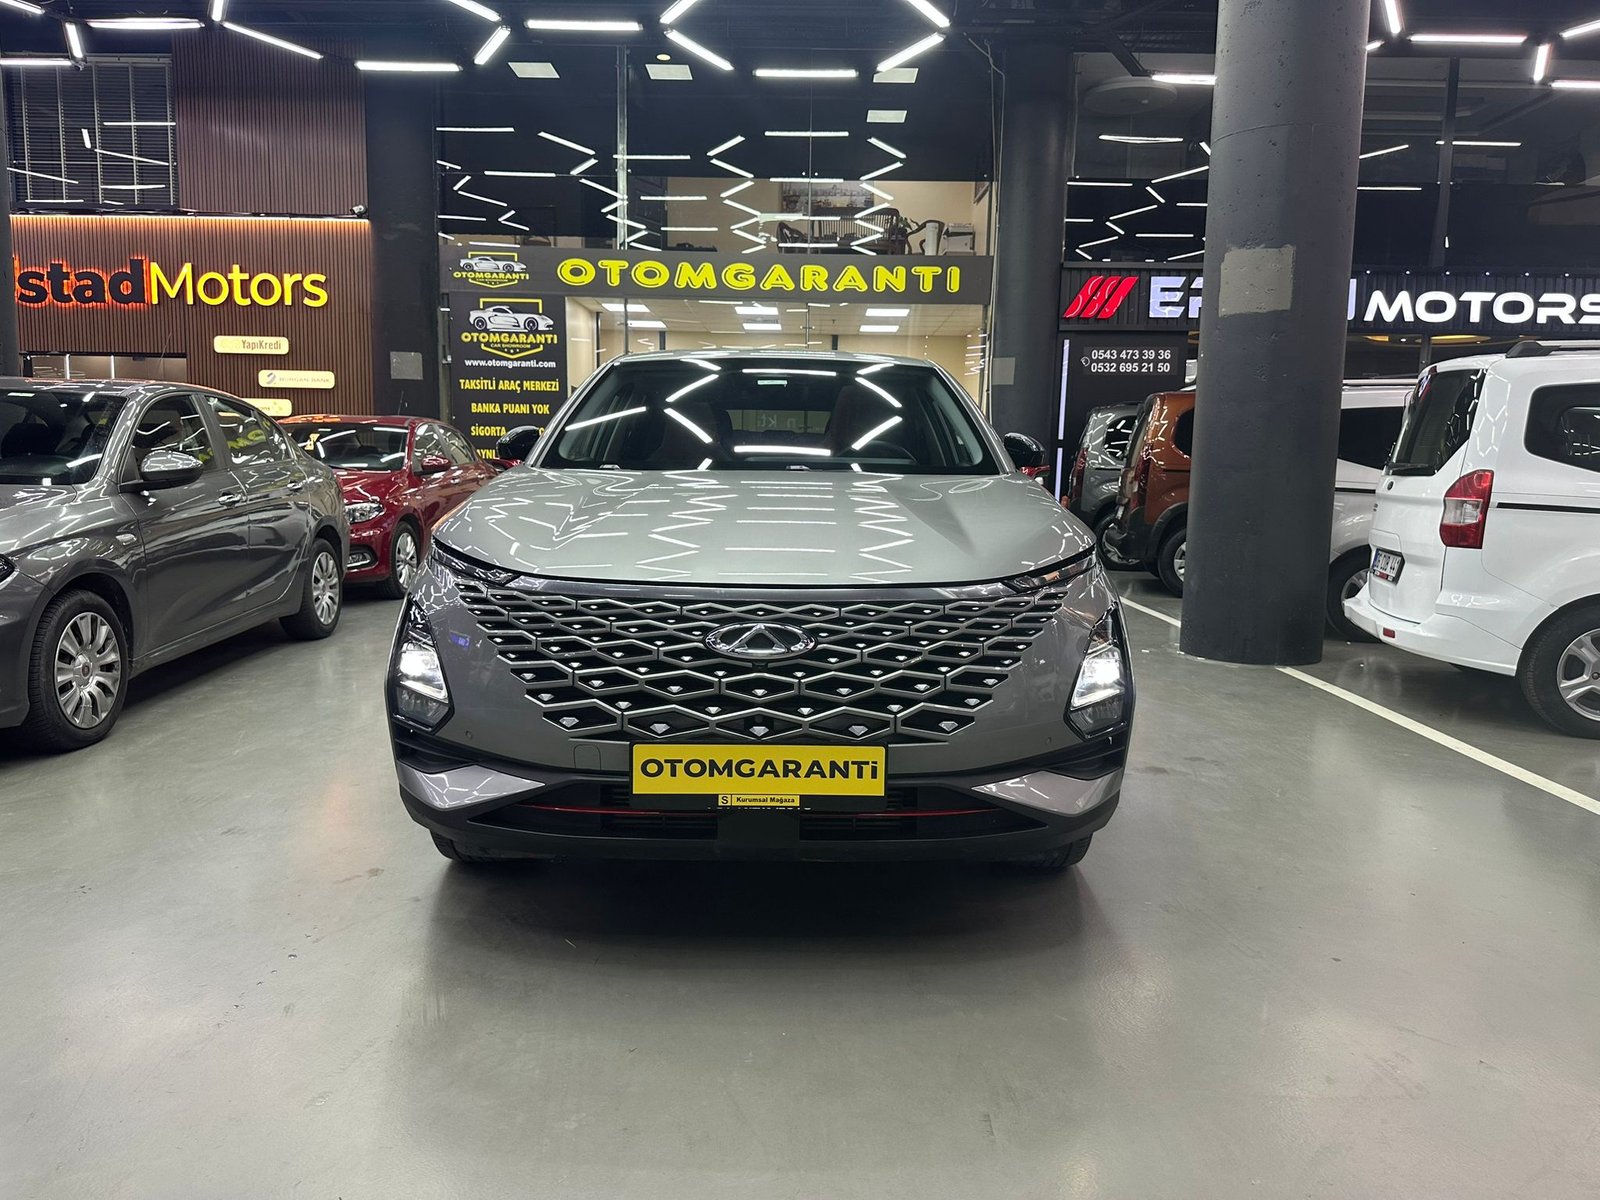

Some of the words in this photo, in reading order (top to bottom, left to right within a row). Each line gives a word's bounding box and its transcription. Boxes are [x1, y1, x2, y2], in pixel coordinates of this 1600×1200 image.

[453, 271, 530, 280] OTOMGARANTI
[556, 257, 961, 293] OTOMGARANTI
[15, 257, 328, 308] stadMotors
[461, 332, 558, 344] OTOMGARANTI
[1091, 350, 1117, 359] 0543
[1120, 350, 1139, 359] 473
[1142, 350, 1155, 359] 39
[1157, 350, 1171, 359] 36
[464, 359, 556, 369] www.otomgaranti.com
[1091, 362, 1117, 372] 0532
[1119, 362, 1139, 372] 695
[1141, 362, 1154, 372] 21
[1157, 362, 1170, 372] 50
[459, 377, 496, 390] TAKSİTLİ
[498, 380, 521, 393] ARAÇ
[523, 378, 559, 392] MERKEZİ
[471, 403, 501, 413] BANKA
[503, 404, 530, 414] PUANI
[532, 404, 550, 415] YOK
[470, 423, 507, 436] SİGORTA
